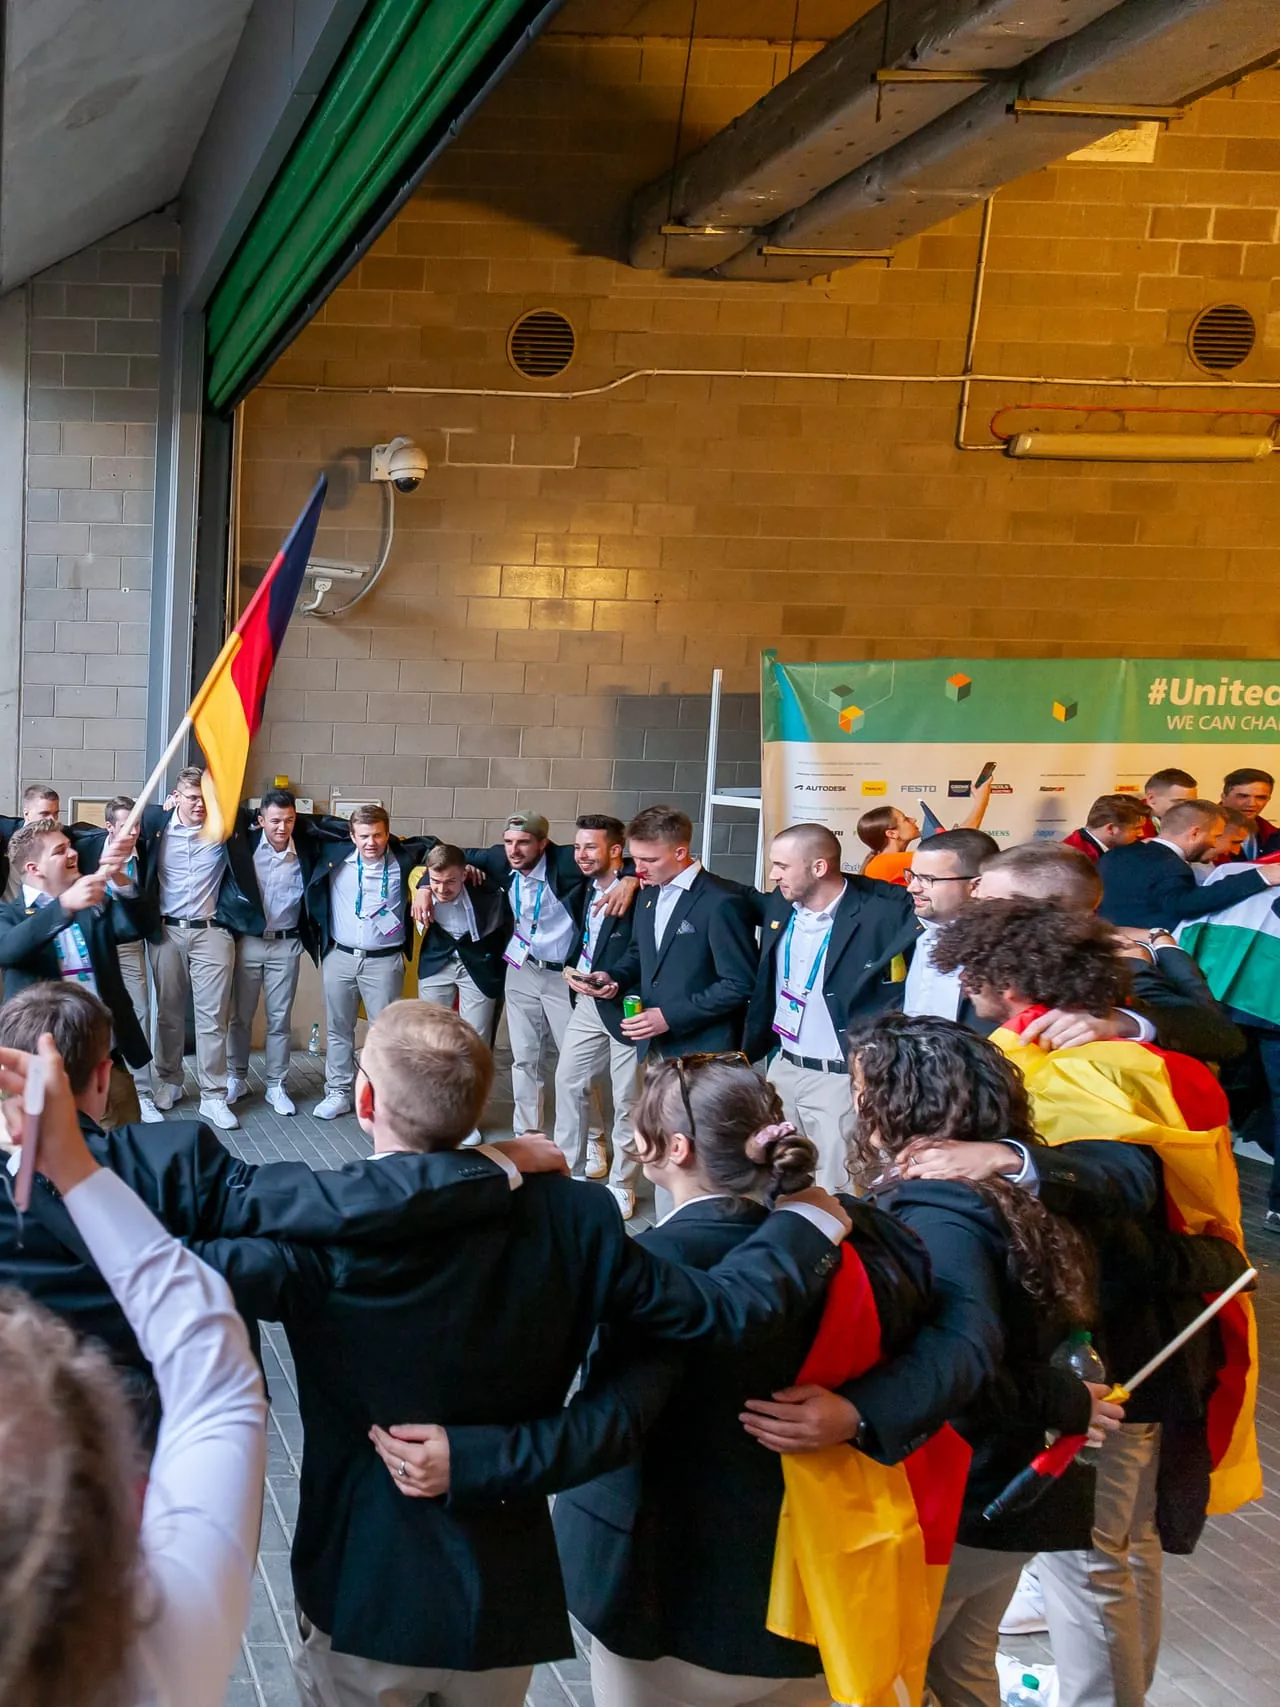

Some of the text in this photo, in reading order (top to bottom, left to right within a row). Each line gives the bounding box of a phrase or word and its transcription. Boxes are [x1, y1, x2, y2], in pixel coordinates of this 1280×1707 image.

[1167, 715, 1280, 730] WE CAN CHA
[900, 785, 937, 793] FESTO
